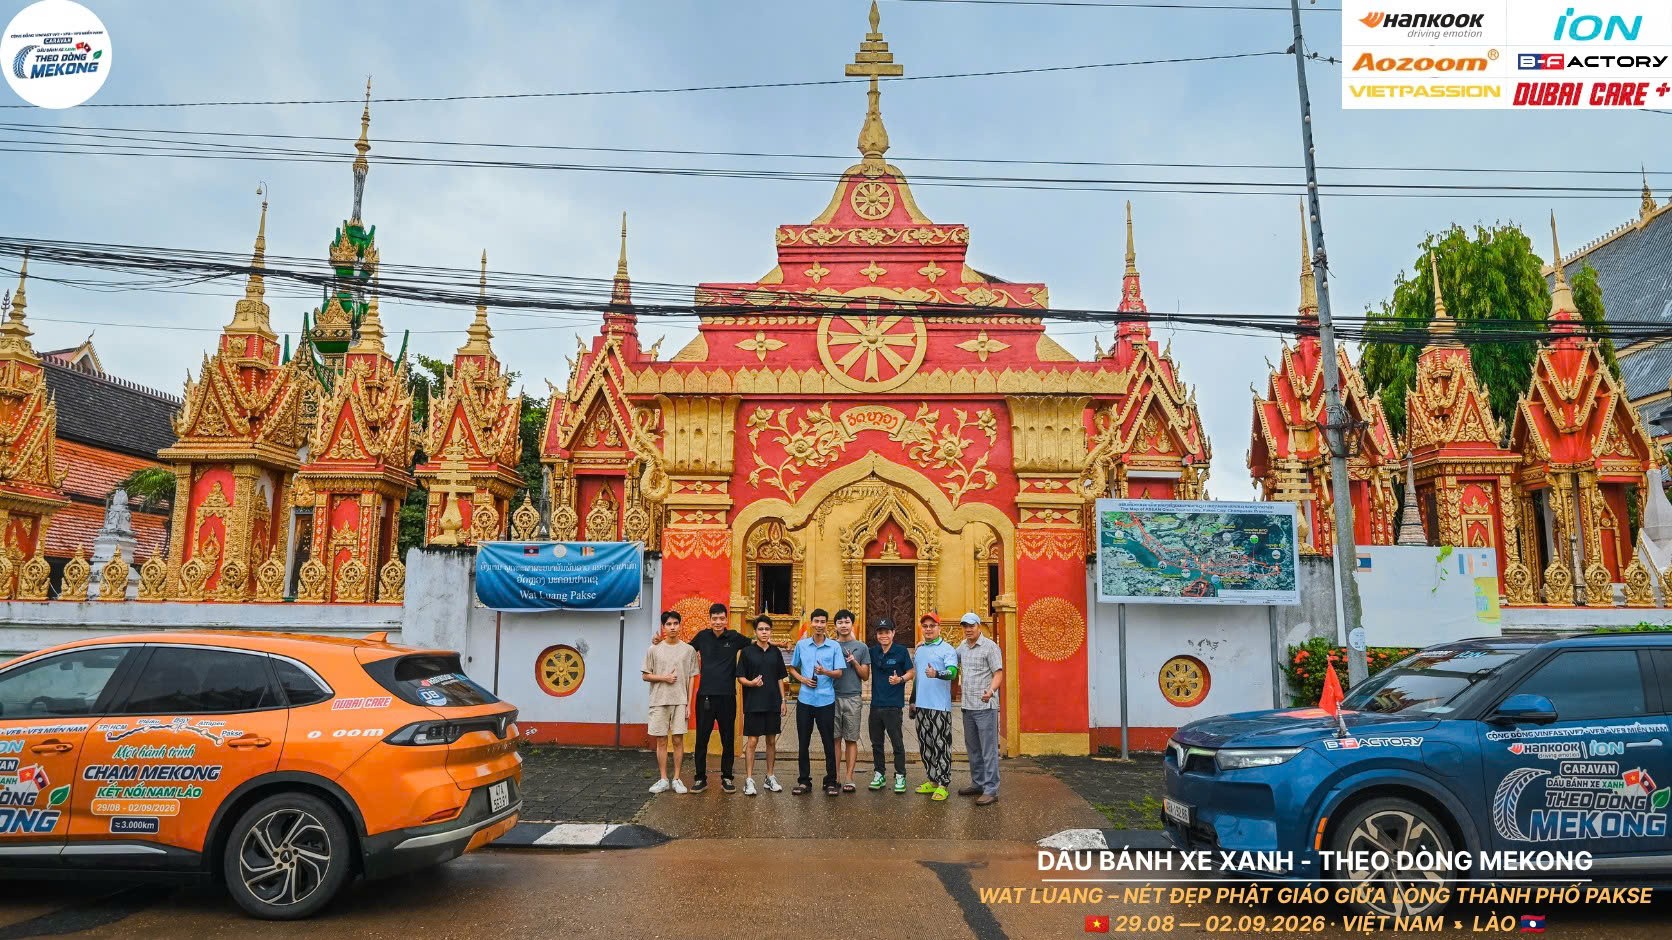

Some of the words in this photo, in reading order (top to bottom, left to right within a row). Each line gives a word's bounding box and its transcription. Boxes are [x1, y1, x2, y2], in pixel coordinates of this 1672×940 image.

[520, 590, 537, 599] Wat
[539, 590, 567, 601] Luang
[570, 590, 596, 600] Pakse
[333, 698, 363, 709] DUBAI
[365, 697, 391, 707] CARE
[140, 745, 166, 758] hành
[168, 745, 194, 758] trình
[84, 766, 138, 782] CHẠM
[139, 766, 221, 780] MEKONG
[1564, 764, 1616, 774] CARAVAN
[1566, 777, 1588, 787] BÁNH
[97, 783, 121, 797] KẾT
[123, 783, 147, 797] NỐI
[148, 787, 175, 797] NAM
[1546, 791, 1594, 807] THEO
[1596, 790, 1647, 809] DÒNG
[97, 803, 120, 812] 29/08
[128, 804, 175, 812] 02/09/2026
[121, 821, 154, 829] 3.000km
[1530, 811, 1666, 841] MEKONG
